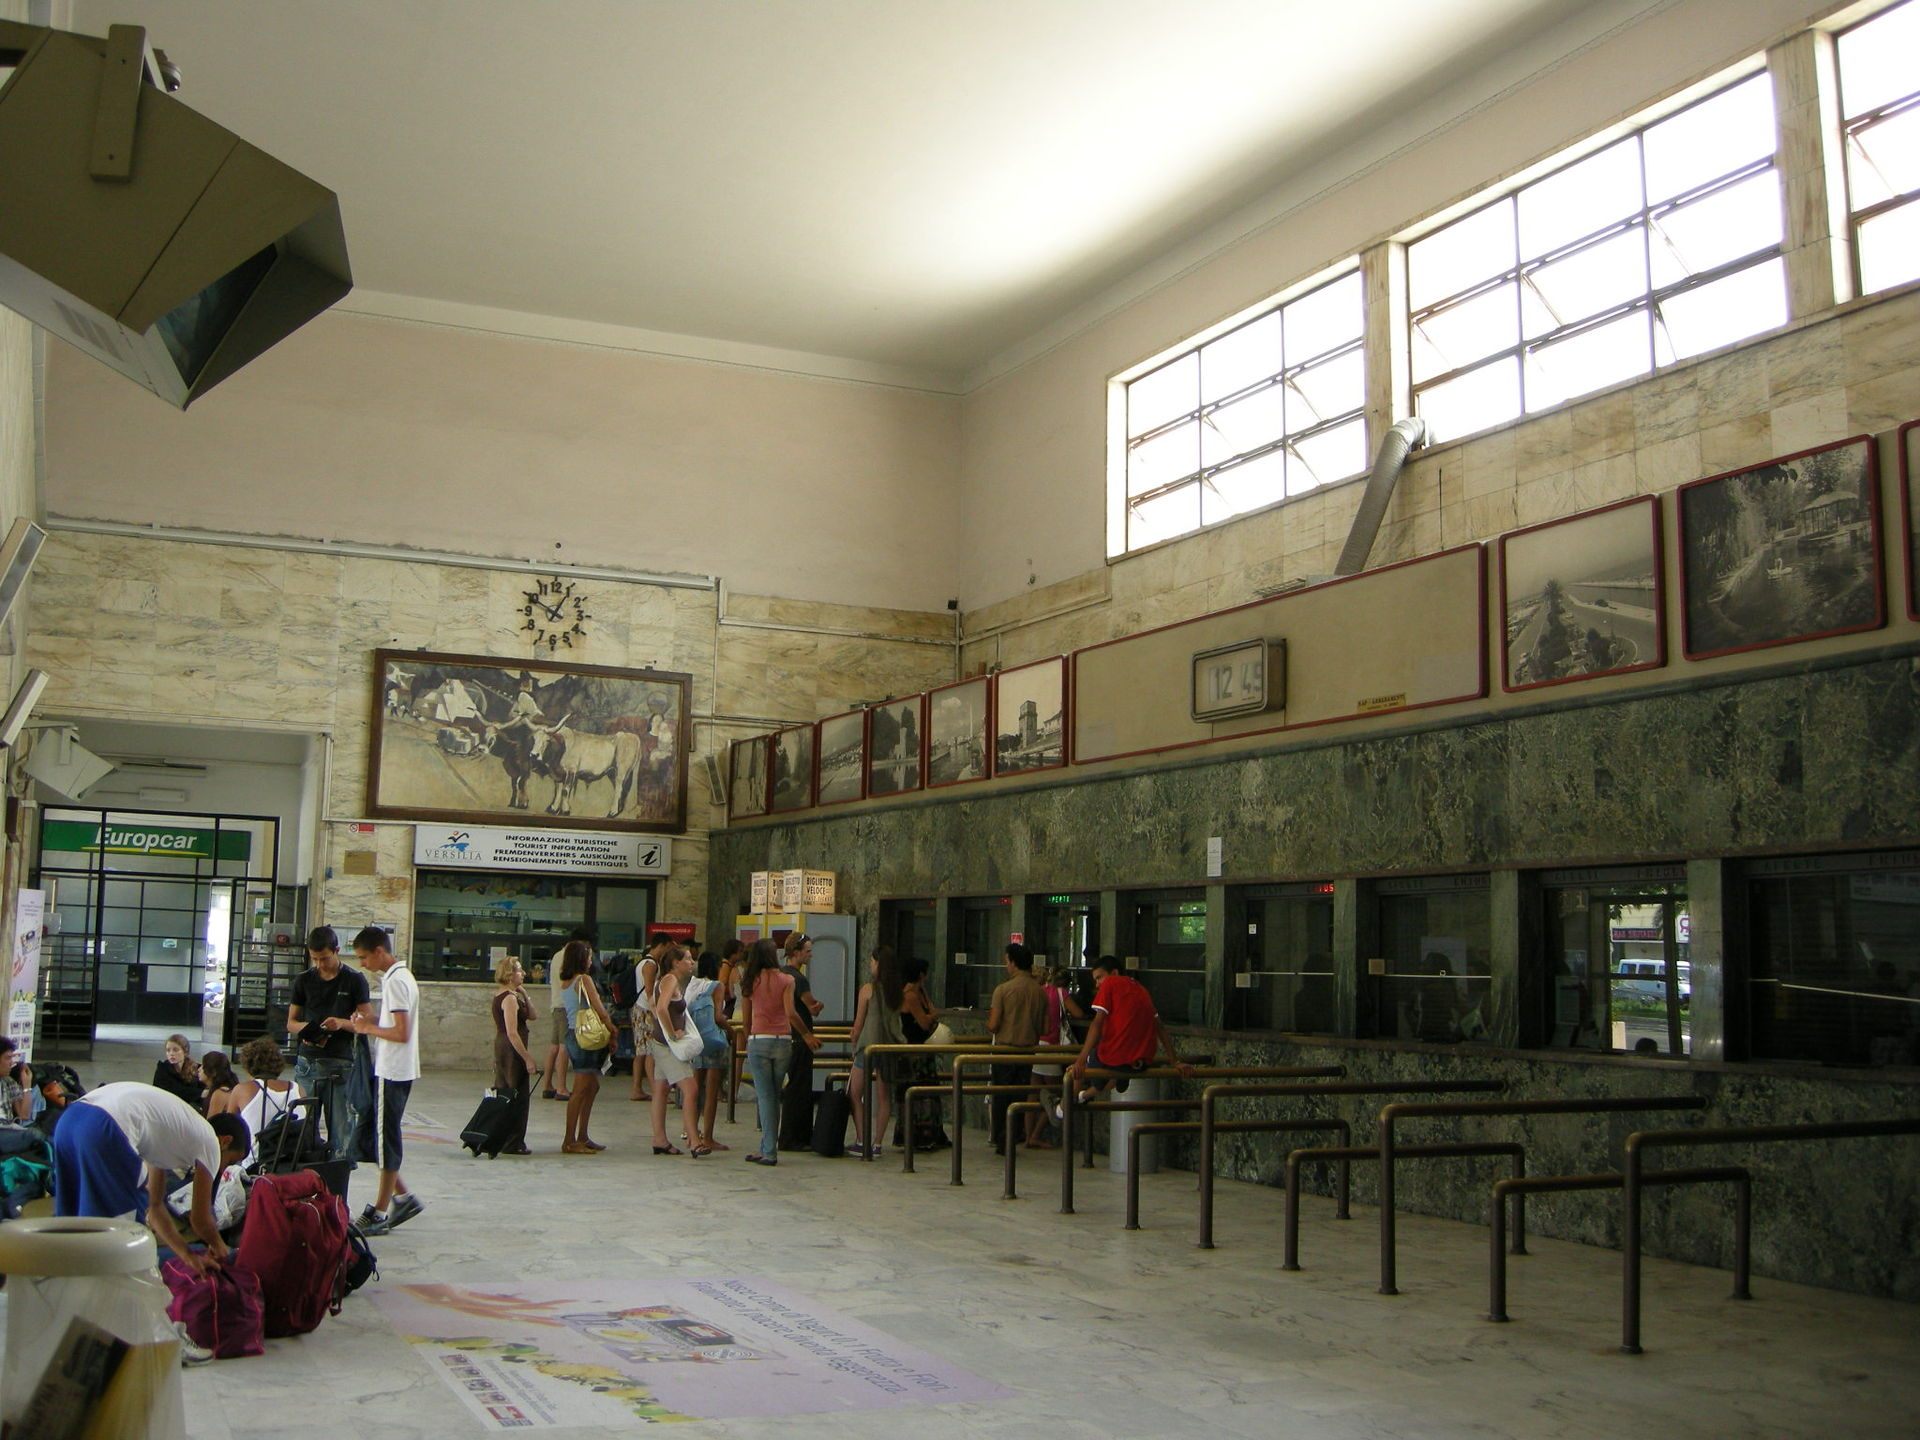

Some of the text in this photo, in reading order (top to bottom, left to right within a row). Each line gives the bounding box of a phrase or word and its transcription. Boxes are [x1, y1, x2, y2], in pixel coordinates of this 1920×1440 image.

[551, 582, 562, 593] 12
[574, 597, 581, 608] 2
[525, 606, 532, 616] 9
[576, 610, 584, 621] 3
[528, 619, 535, 630] 8
[571, 623, 581, 634] 4
[538, 629, 545, 641] 7
[549, 634, 557, 645] 6
[562, 632, 570, 643] 5
[95, 826, 197, 852] Europcar
[505, 835, 618, 847] INFORMAZIONI TURISTICHE
[514, 842, 610, 853] TOURIST INFORMATION
[425, 849, 482, 861] VERSILIA
[494, 848, 627, 861] FREMDENVERKEHRS AUSKÜNFTE
[493, 856, 629, 868] RENSEIGNEMENTS TOURISTIQUES
[806, 877, 833, 887] BIGLIETTO
[806, 886, 826, 895] VELOCE
[735, 1313, 794, 1333] piacere
[783, 1333, 838, 1356] diventa
[748, 1295, 791, 1312] Crema
[796, 1318, 844, 1338] Yogurt
[853, 1348, 903, 1368] Frutta
